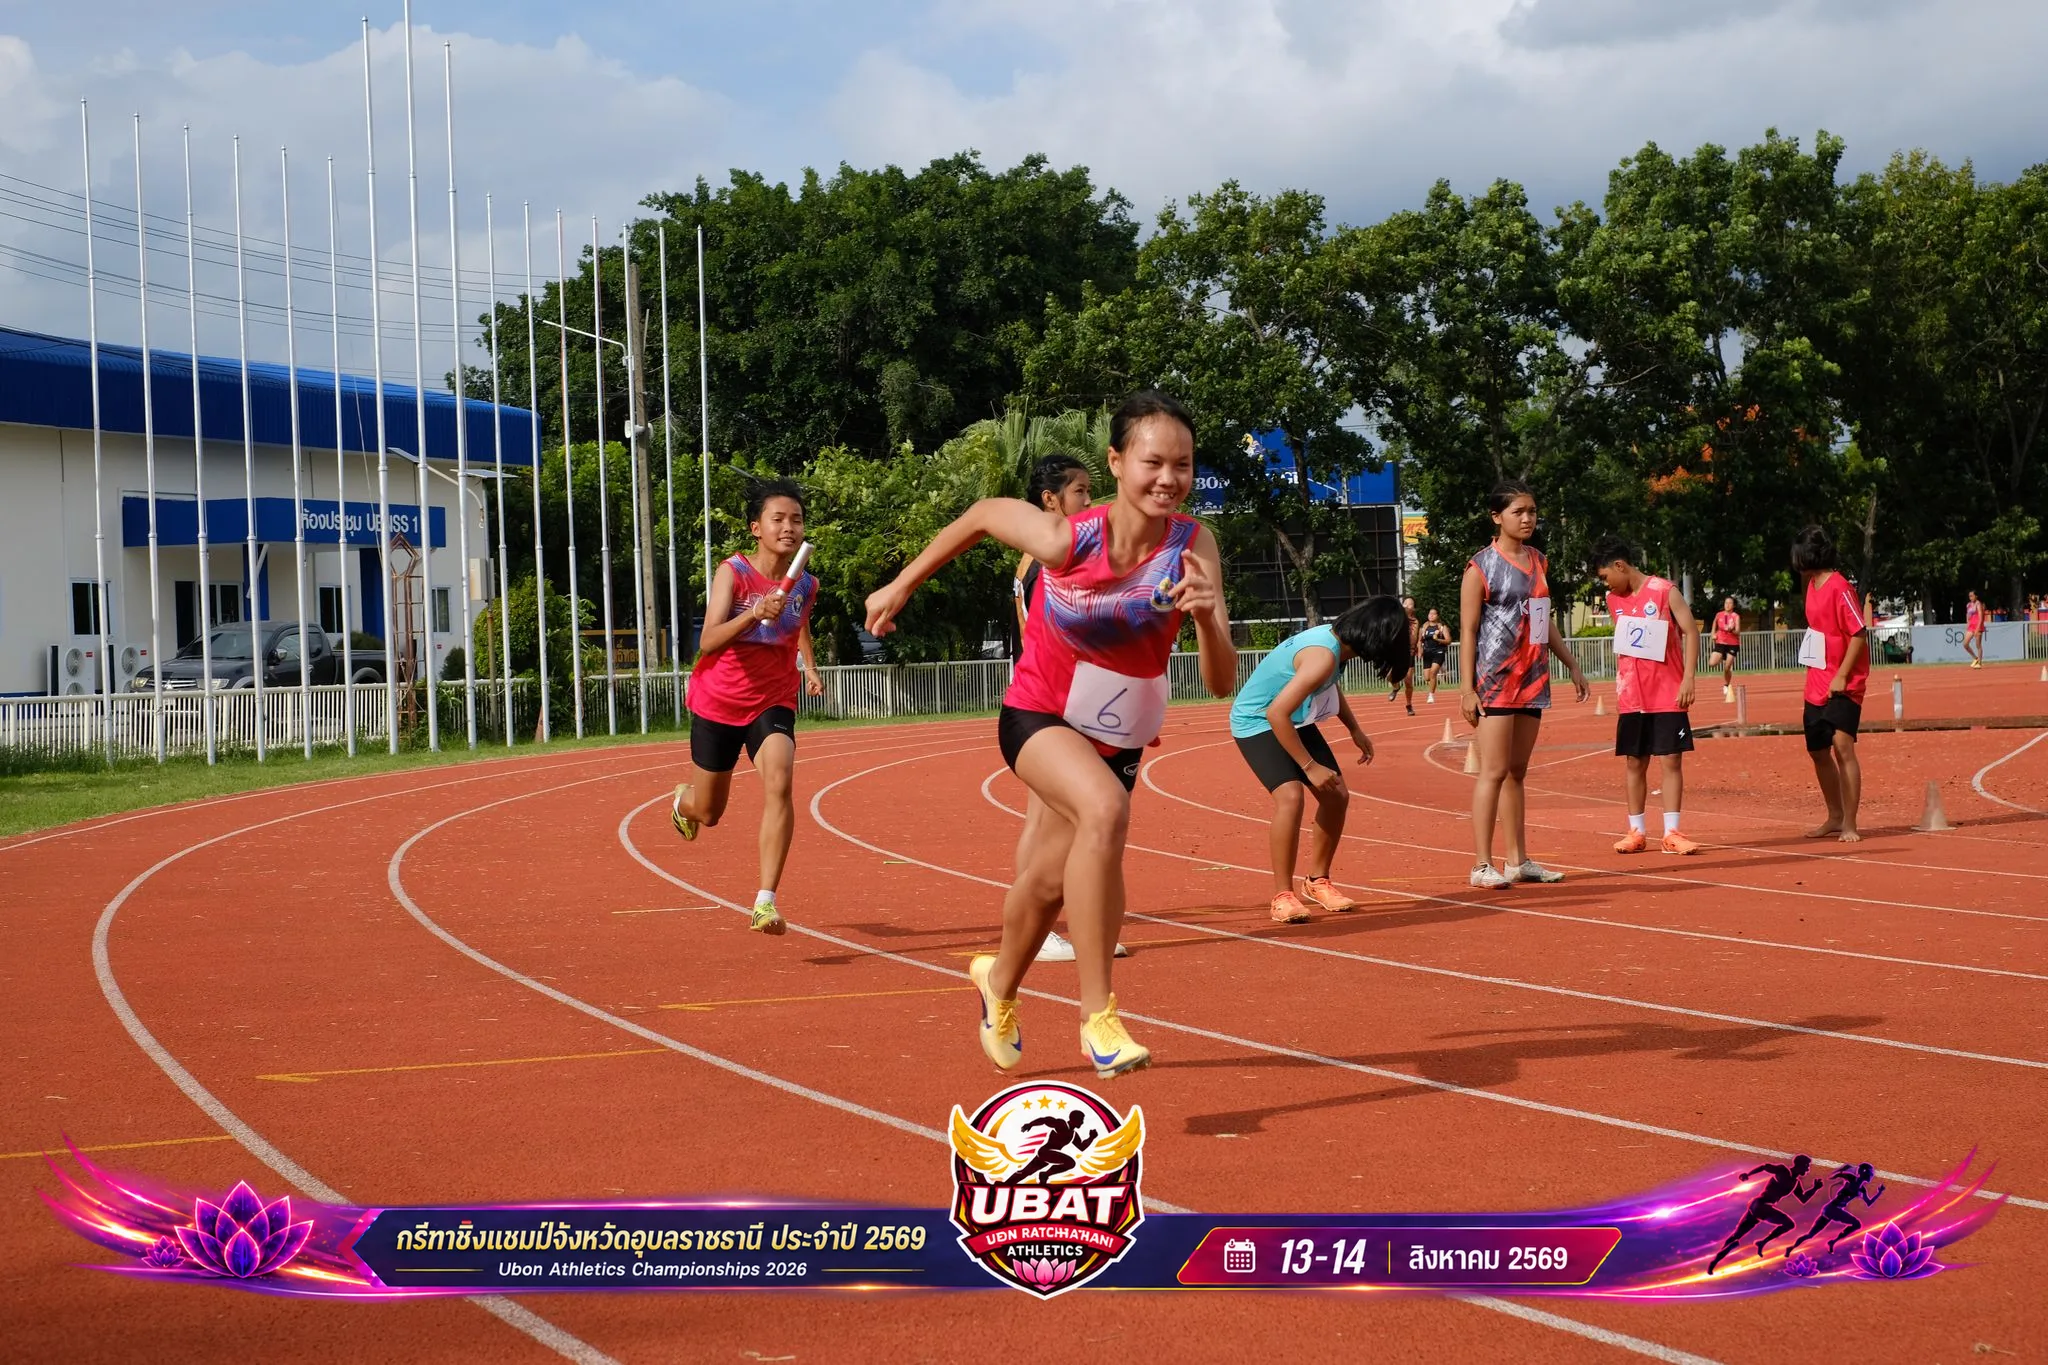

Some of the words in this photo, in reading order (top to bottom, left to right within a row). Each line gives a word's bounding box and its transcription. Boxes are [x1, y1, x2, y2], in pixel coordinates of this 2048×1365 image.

[302, 509, 362, 537] ห้องปรชุม
[412, 516, 418, 533] 1
[1630, 627, 1643, 648] 2
[1803, 634, 1817, 659] 1
[1945, 627, 1989, 646] Spt
[1097, 687, 1128, 729] 6
